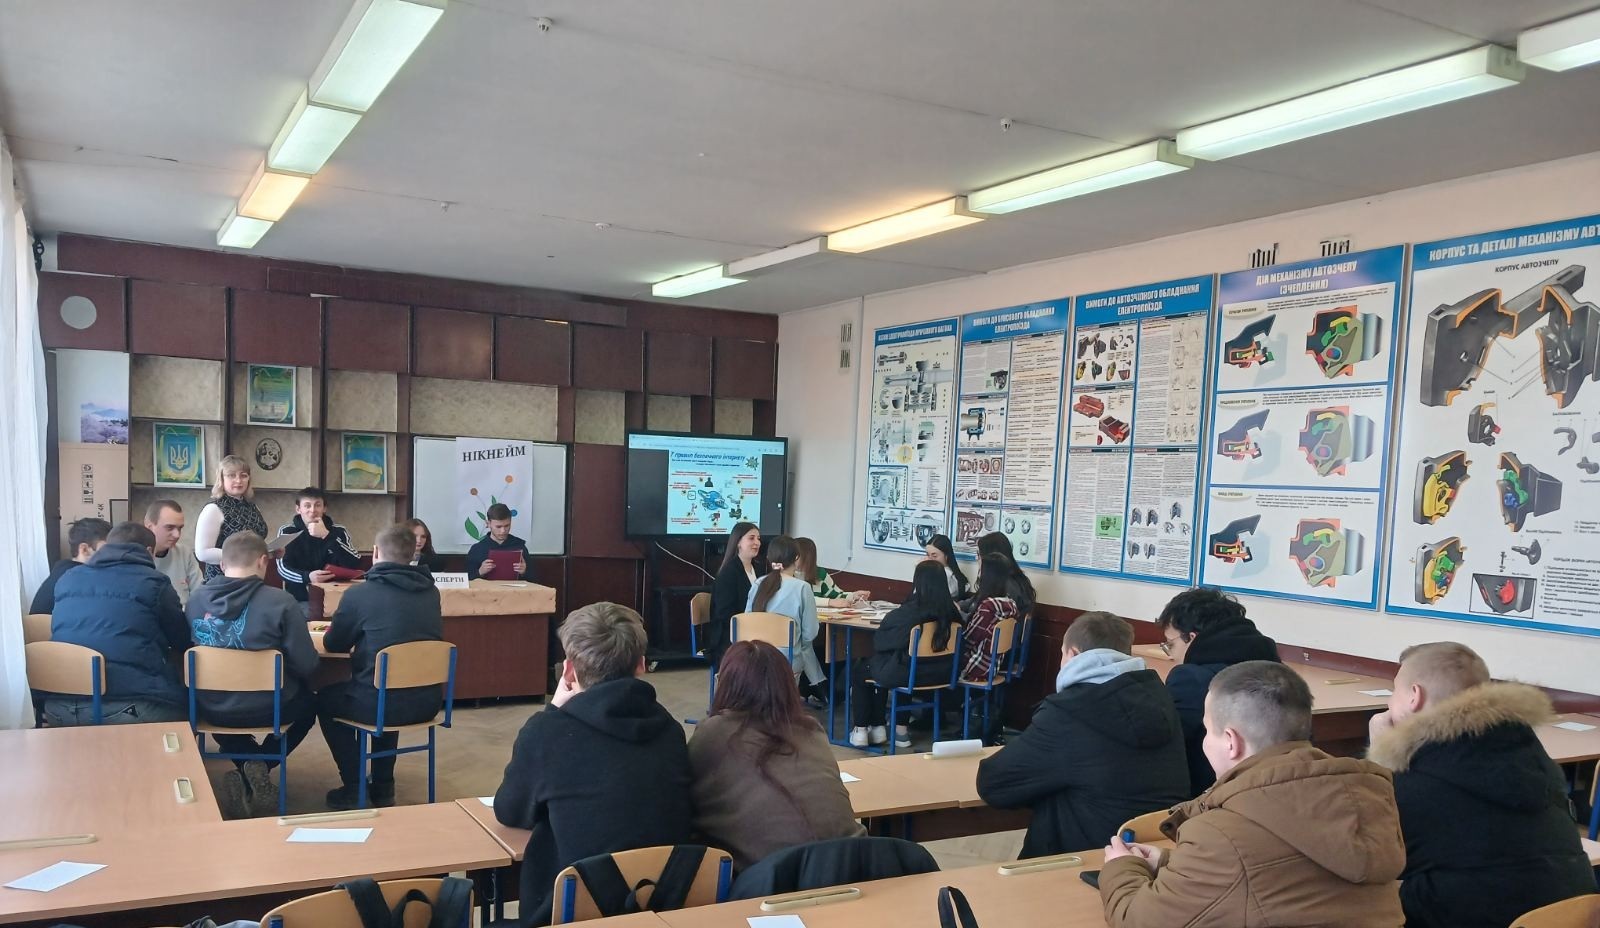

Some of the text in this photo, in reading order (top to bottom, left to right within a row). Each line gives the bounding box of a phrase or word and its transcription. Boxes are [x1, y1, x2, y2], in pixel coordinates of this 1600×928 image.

[1429, 245, 1466, 262] КОРПУС
[1467, 243, 1480, 257] ТА
[1480, 237, 1516, 255] ДЕТАЛІ
[1518, 226, 1580, 248] МЕХАНІЗМУ
[1270, 269, 1312, 284] МЕХАНІЗМУ
[1313, 260, 1358, 277] АВТОЗЧЕПУ
[1494, 258, 1559, 273] КОРПУС АВТОЗЧЕПУ
[1108, 296, 1116, 307] ДО
[1159, 283, 1200, 298] ОБЛАДНАННЯ
[1117, 300, 1163, 316] ЕЛЕКТРОПОЇЗДА
[462, 444, 525, 462] НІКНЕЙМ
